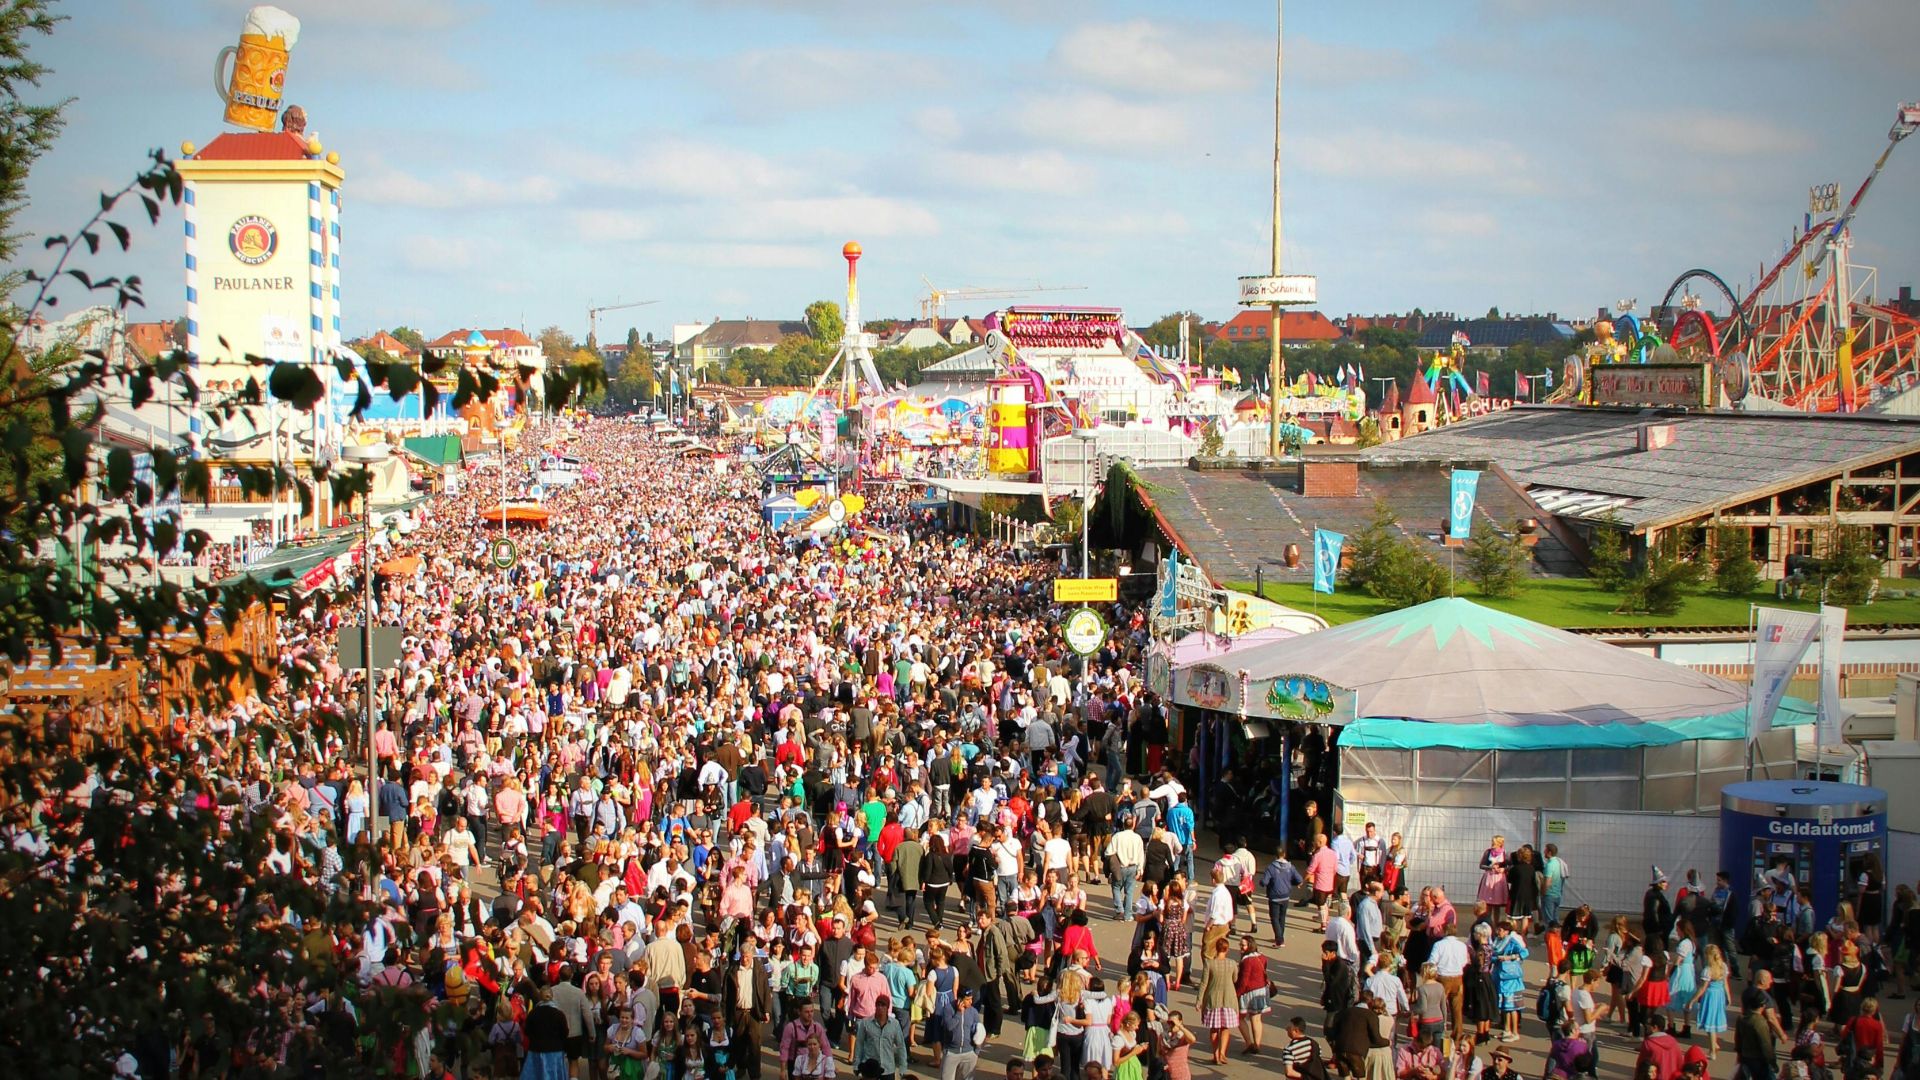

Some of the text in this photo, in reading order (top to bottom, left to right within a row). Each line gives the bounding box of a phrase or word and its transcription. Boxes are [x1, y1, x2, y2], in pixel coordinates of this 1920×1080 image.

[231, 216, 276, 235] PAULANER
[213, 276, 294, 290] PAULANER
[1460, 398, 1523, 415] SCHLO
[1769, 820, 1876, 836] Geldautomat
